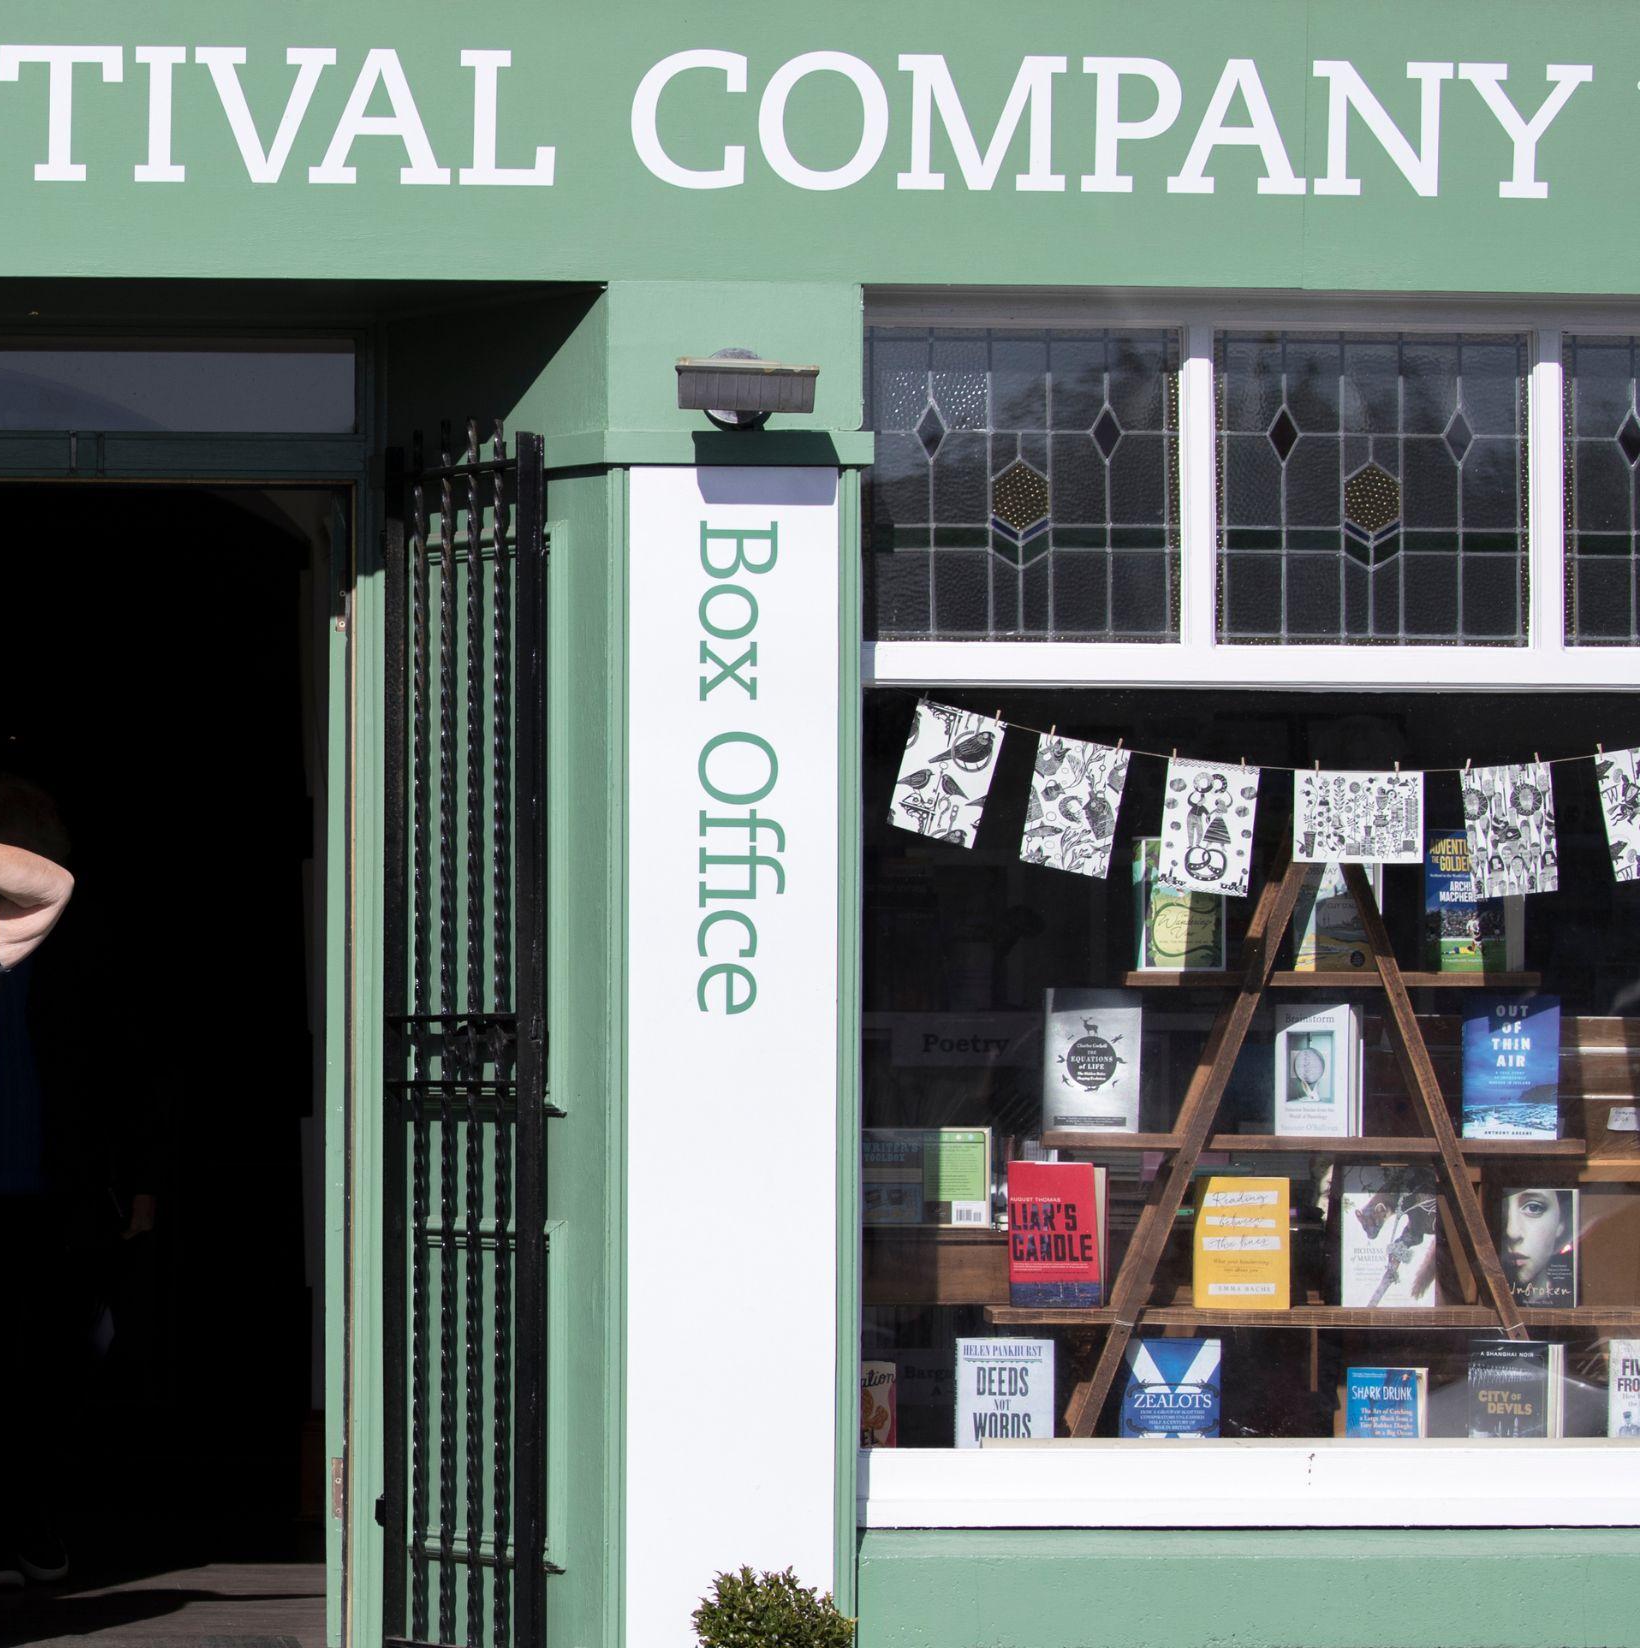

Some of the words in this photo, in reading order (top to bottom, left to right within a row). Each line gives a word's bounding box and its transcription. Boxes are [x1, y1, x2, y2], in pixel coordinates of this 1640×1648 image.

[630, 49, 1594, 199] COMPANY
[697, 521, 779, 702] Box
[696, 731, 787, 1016] Office
[1285, 1013, 1335, 1024] Brainstorm
[1496, 1005, 1529, 1017] OUT
[1502, 1021, 1522, 1034] OF
[922, 1033, 1010, 1057] Poetry
[1492, 1038, 1531, 1050] THIN
[1496, 1055, 1526, 1067] AIR
[1011, 1203, 1077, 1232] LIAR'S
[1012, 1233, 1093, 1262] CANDLE
[963, 1345, 991, 1356] HELEN
[992, 1345, 1043, 1357] PANKHURST
[976, 1366, 1029, 1397] DEEDS
[1133, 1393, 1212, 1408] ZEALOTS
[1351, 1385, 1381, 1400] SHARK
[1383, 1386, 1413, 1401] DRUNK
[1478, 1390, 1509, 1402] CITY
[1511, 1393, 1521, 1401] OF
[993, 1399, 1010, 1410] NOT
[1487, 1403, 1533, 1416] DEVILS
[973, 1412, 1032, 1442] WORDS
